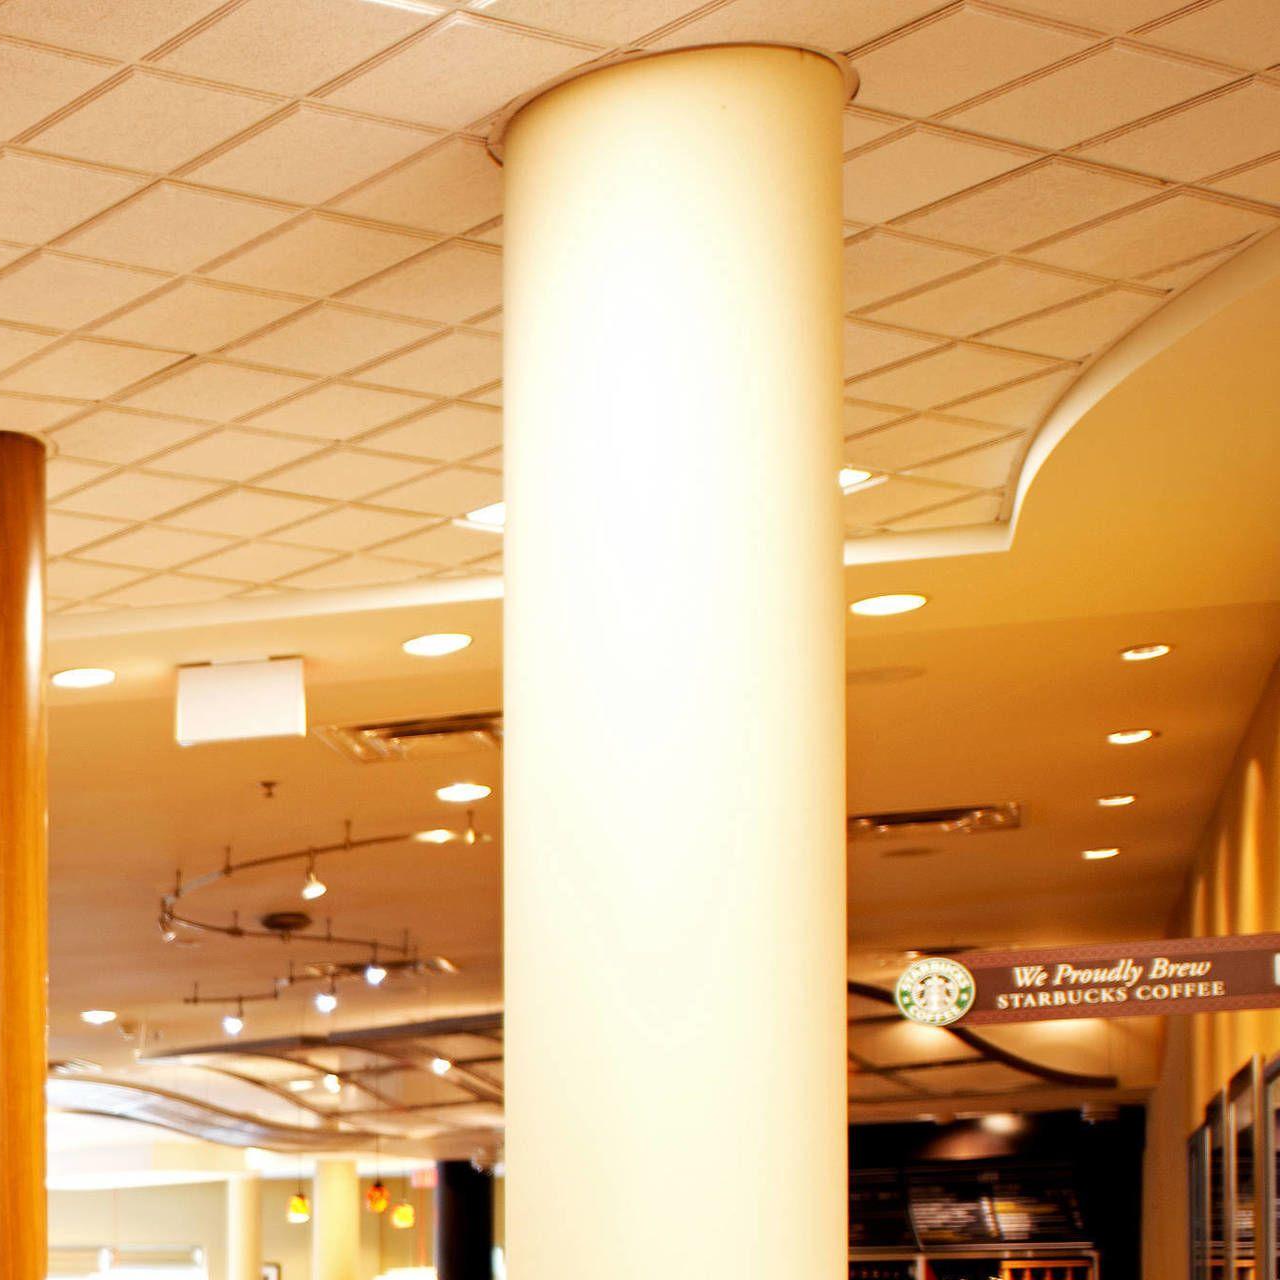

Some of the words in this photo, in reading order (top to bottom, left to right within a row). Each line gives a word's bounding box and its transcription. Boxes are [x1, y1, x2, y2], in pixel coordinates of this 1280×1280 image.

[1013, 965, 1047, 988] We
[1052, 958, 1143, 988] Proudly
[1149, 956, 1212, 980] Brew
[996, 986, 1129, 1011] STARBUCKS
[1136, 981, 1226, 1001] COFFEE
